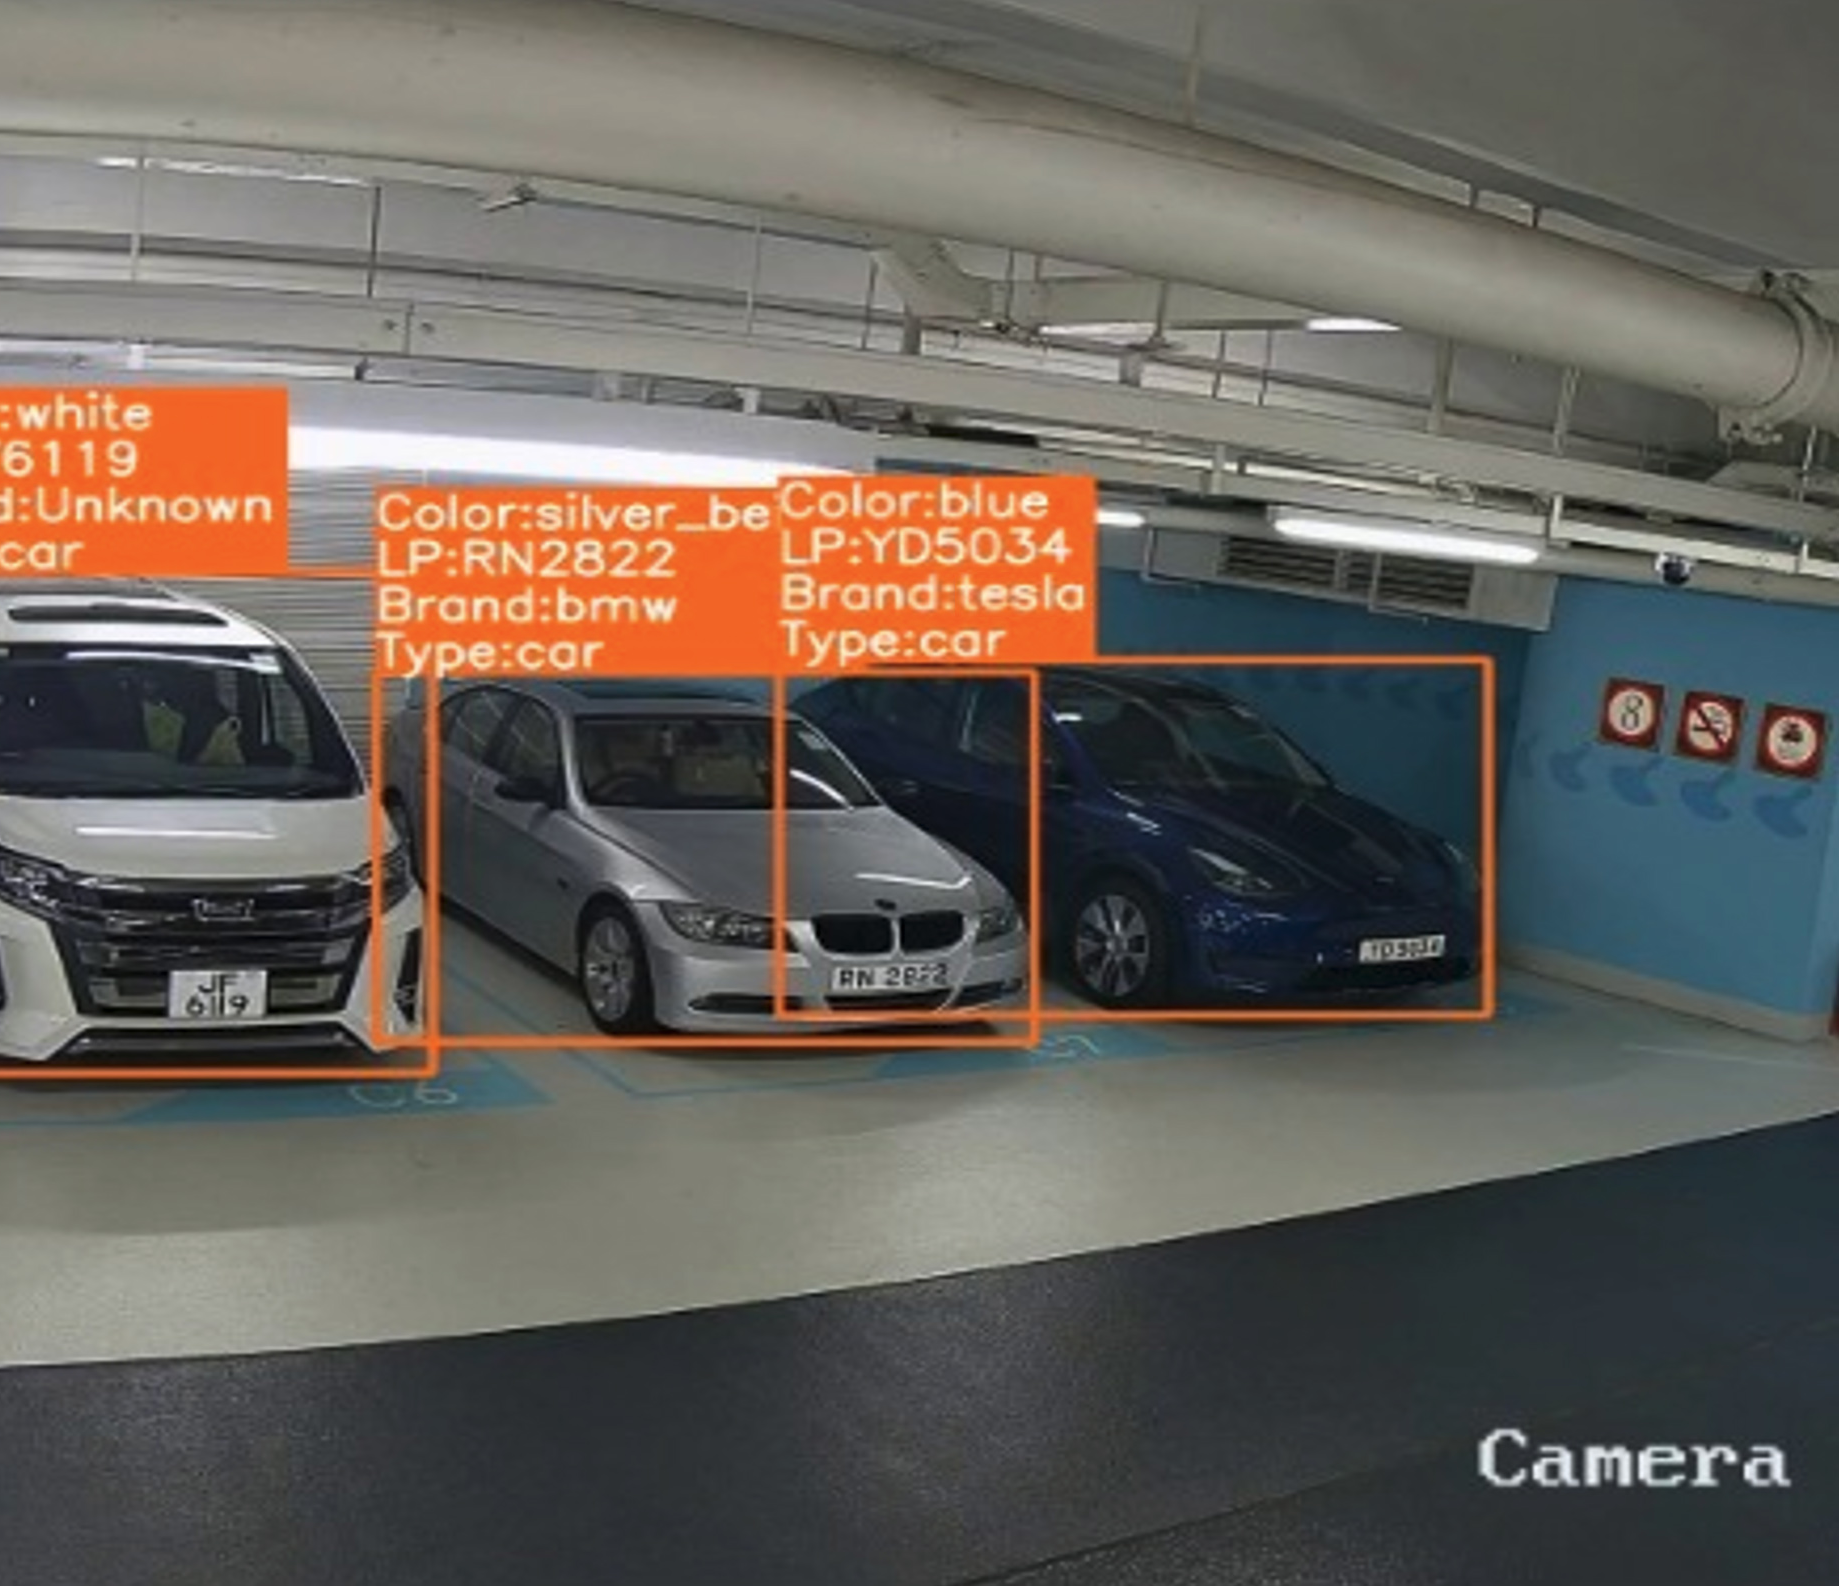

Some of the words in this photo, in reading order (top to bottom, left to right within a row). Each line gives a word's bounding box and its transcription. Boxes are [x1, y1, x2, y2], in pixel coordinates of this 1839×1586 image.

[198, 973, 240, 993] JF
[839, 969, 875, 987] RN
[185, 995, 250, 1016] 6119
